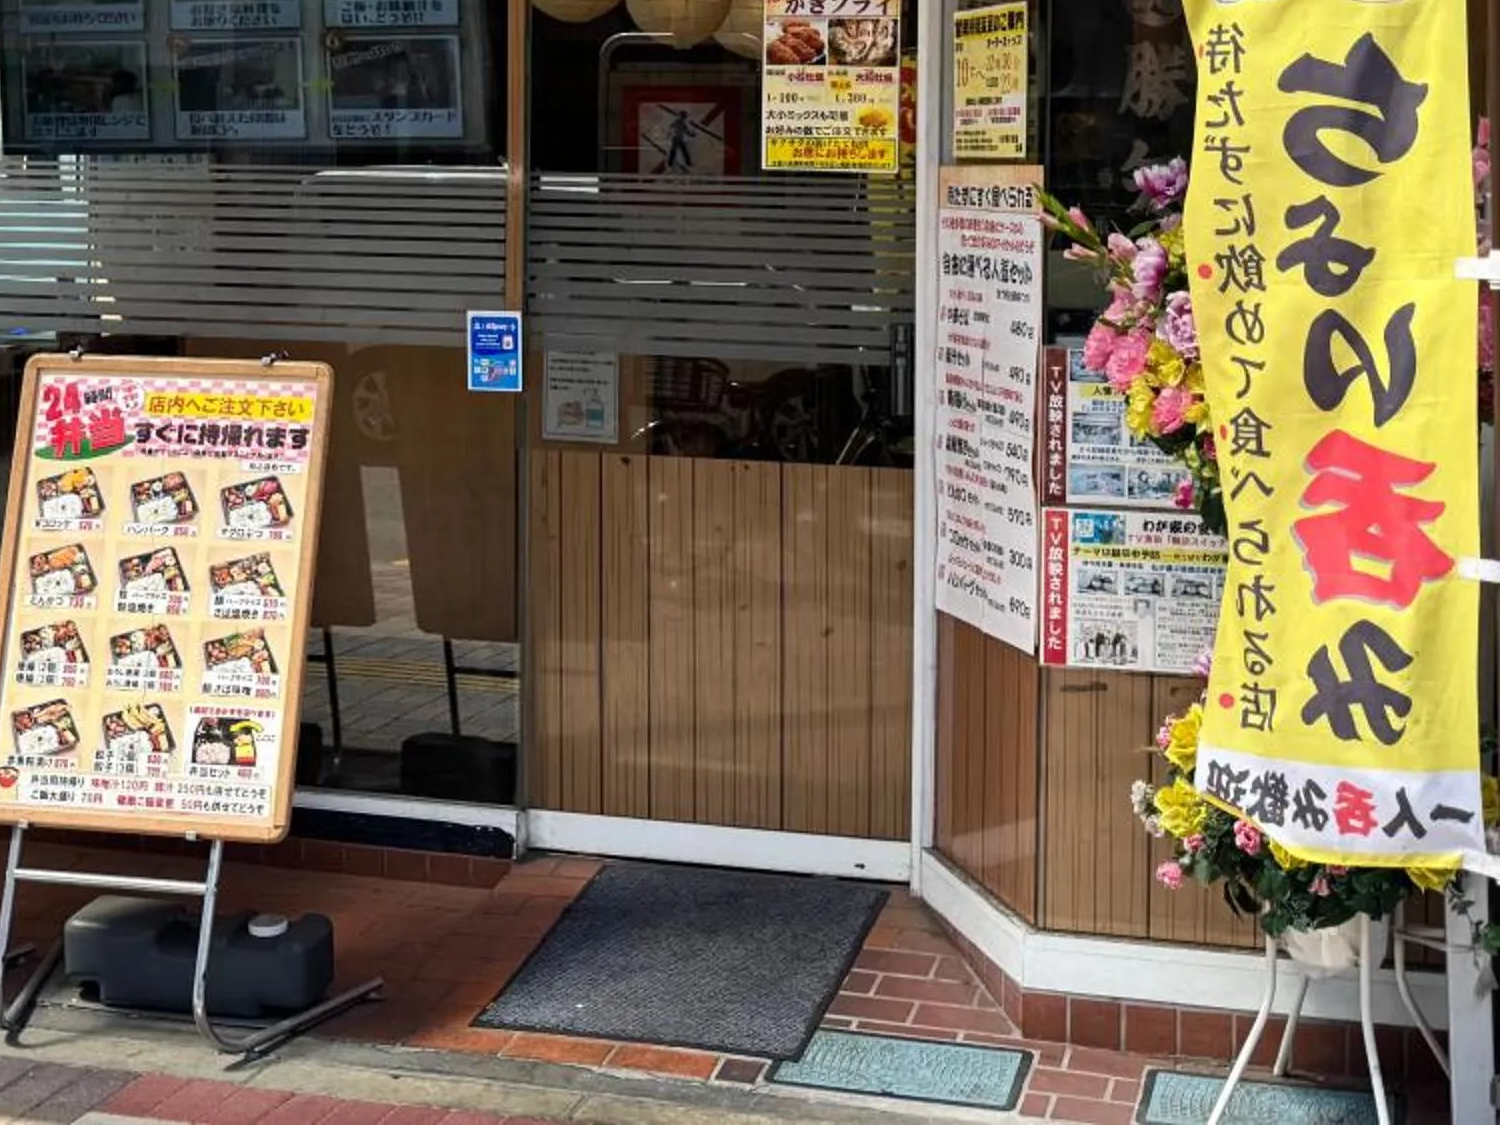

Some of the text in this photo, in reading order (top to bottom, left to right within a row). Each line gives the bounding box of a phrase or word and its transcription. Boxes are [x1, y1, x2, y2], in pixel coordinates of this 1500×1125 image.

[148, 396, 305, 416] 店内へご注文下さい
[135, 422, 310, 449] すぐに持帰れます
